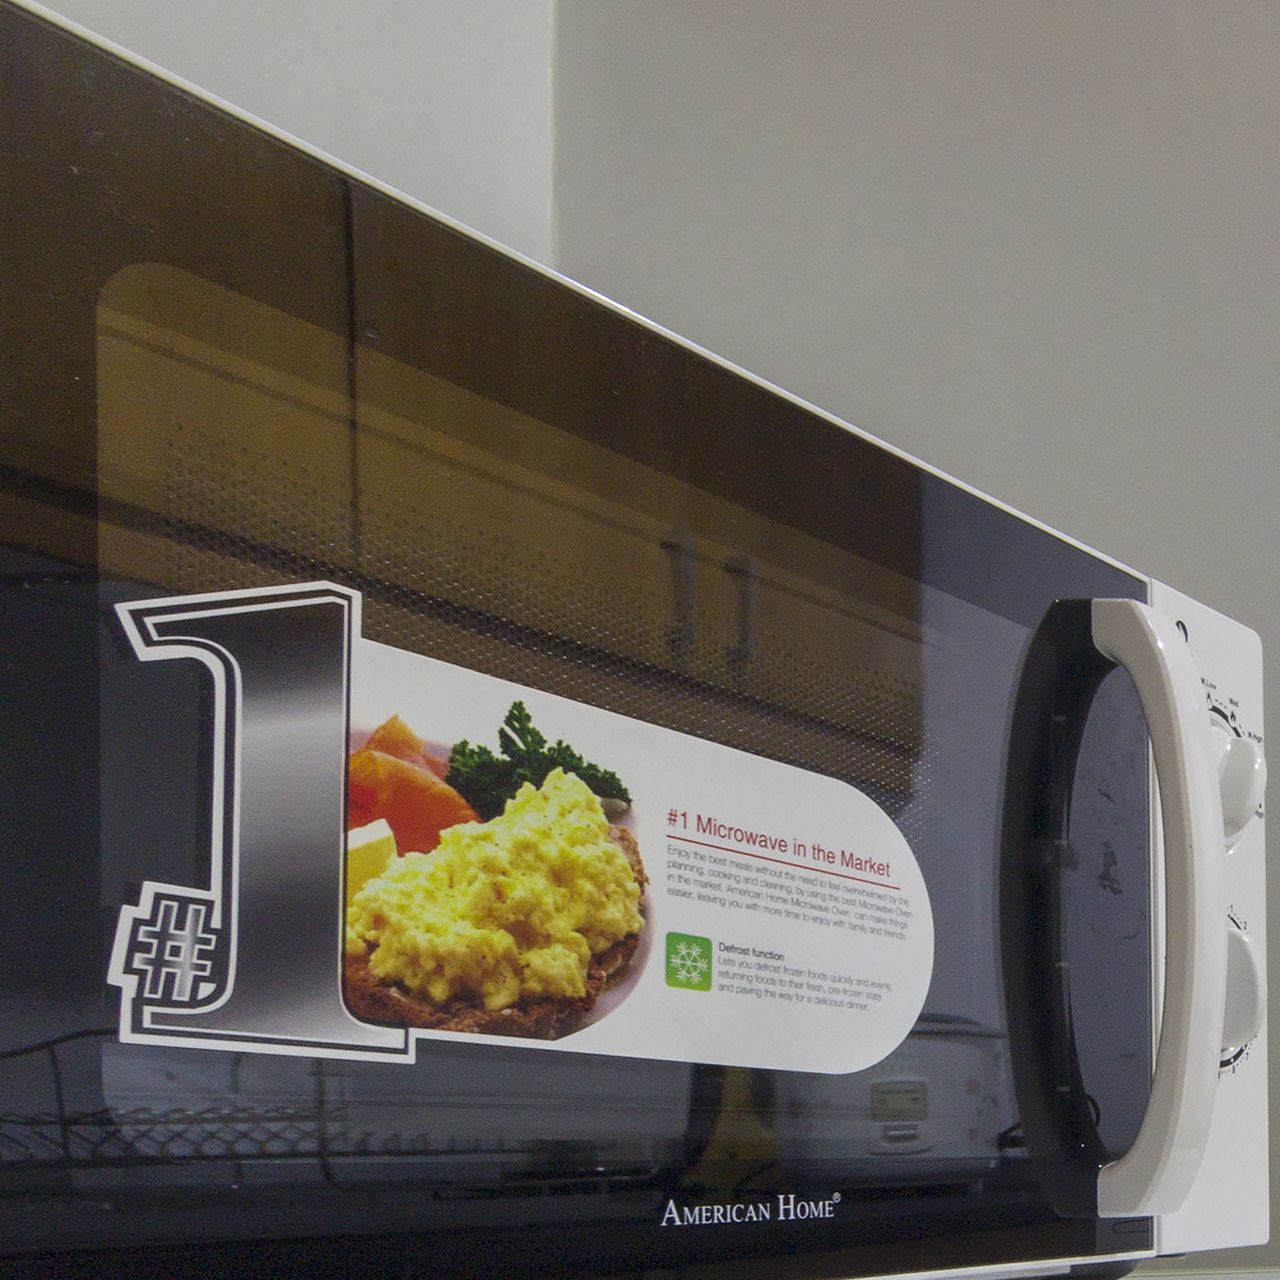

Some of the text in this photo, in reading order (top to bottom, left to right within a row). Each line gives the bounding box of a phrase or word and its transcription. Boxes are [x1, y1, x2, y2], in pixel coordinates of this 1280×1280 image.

[667, 808, 891, 878] #1 Microwave in the Market
